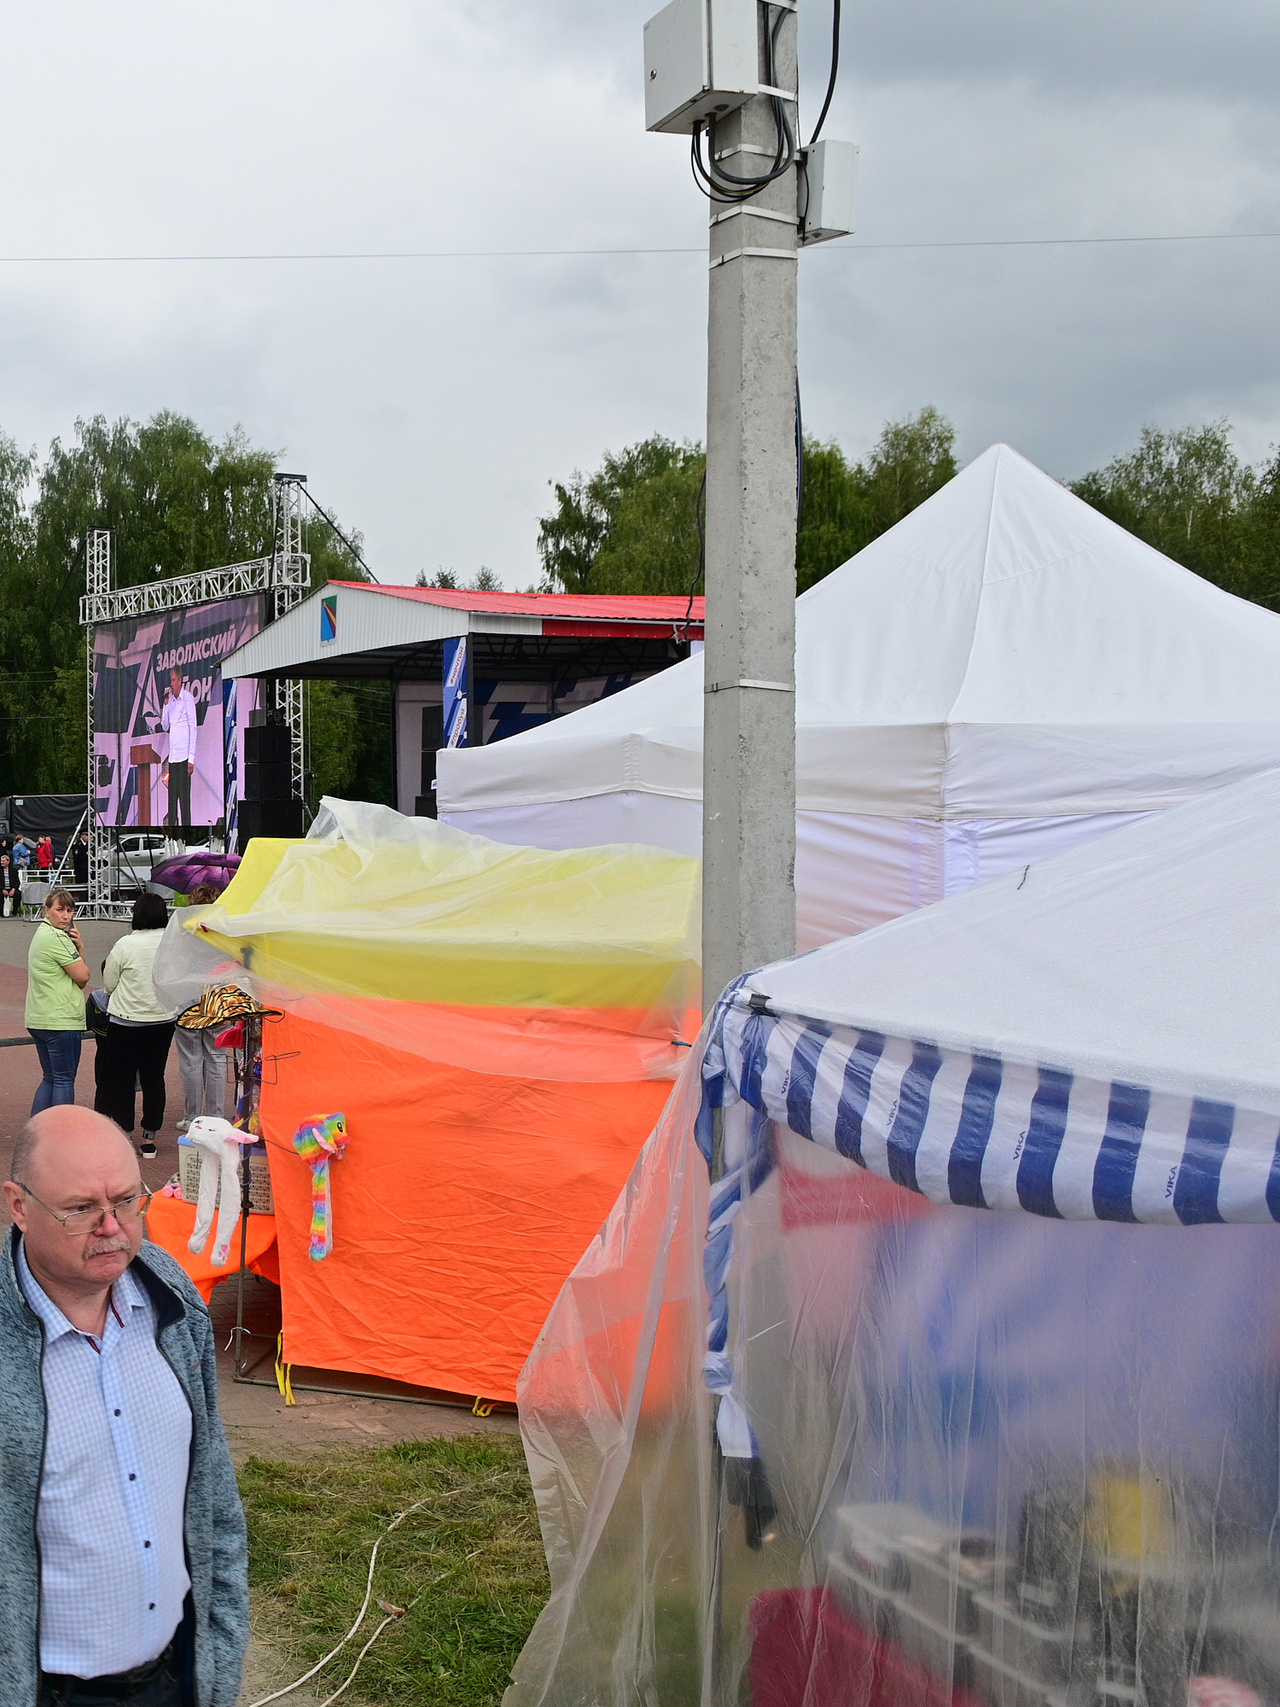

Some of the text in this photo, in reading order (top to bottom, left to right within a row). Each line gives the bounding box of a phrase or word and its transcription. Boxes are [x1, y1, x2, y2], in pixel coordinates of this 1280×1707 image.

[156, 623, 237, 673] ЗАВОЛЖСКИЙ
[450, 707, 465, 746] #пробуй
[781, 1069, 790, 1094] VIKA
[886, 1100, 898, 1126] VIKA
[1012, 1130, 1026, 1160] VIKA
[1164, 1165, 1178, 1199] VIKA
